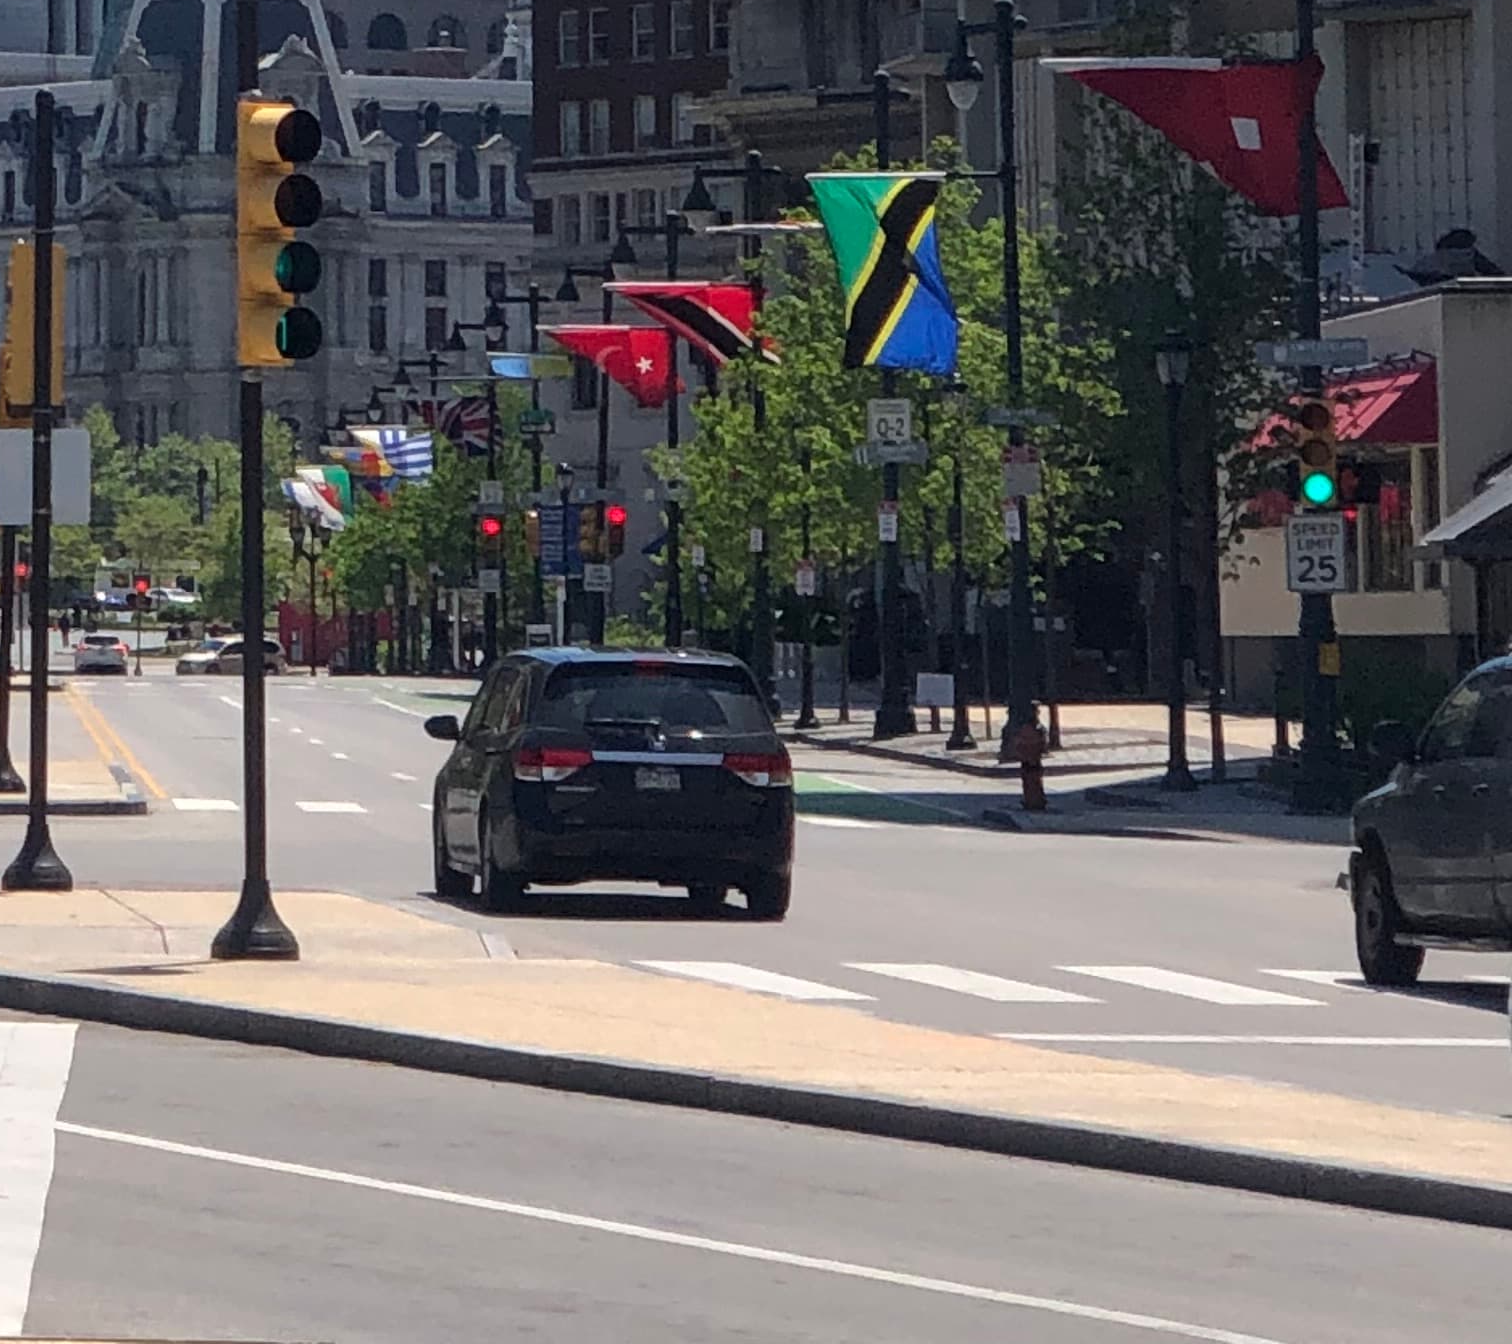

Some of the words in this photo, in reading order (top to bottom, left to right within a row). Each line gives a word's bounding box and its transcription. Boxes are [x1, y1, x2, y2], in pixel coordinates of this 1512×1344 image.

[875, 417, 905, 438] Q-2
[1292, 522, 1340, 536] SPEED
[1296, 538, 1335, 551] LIMIT
[1297, 555, 1338, 584] 25
